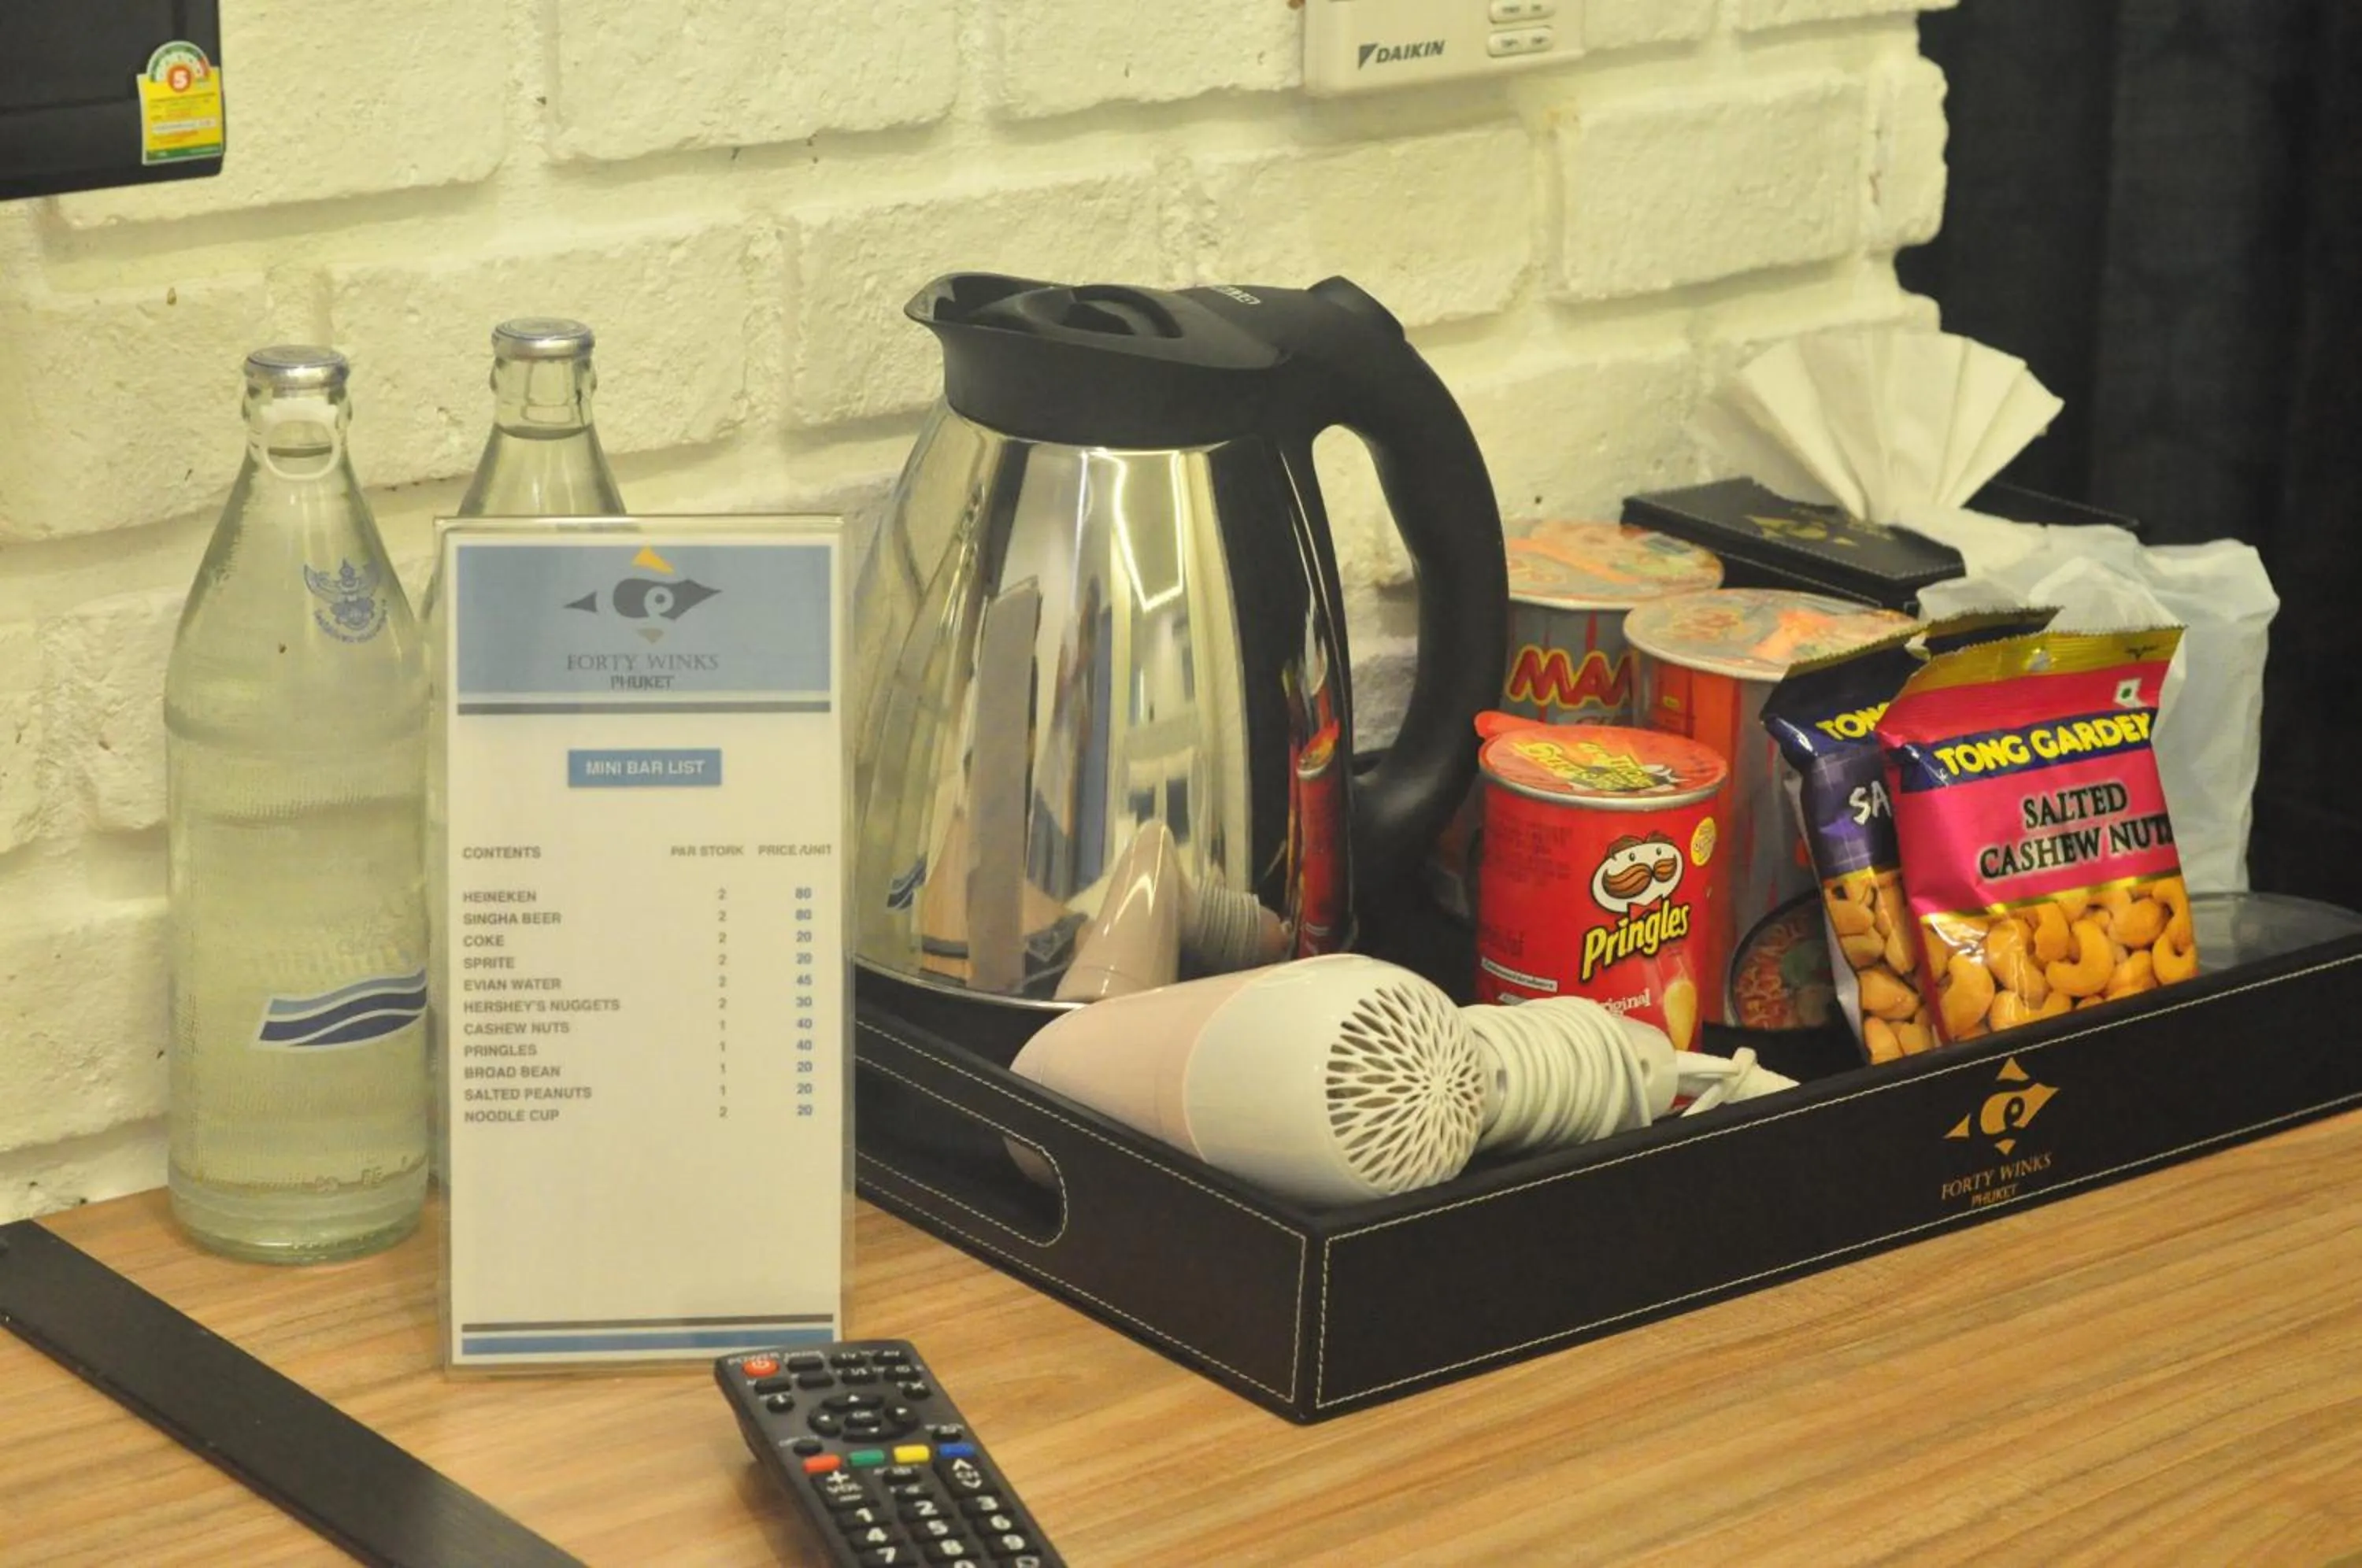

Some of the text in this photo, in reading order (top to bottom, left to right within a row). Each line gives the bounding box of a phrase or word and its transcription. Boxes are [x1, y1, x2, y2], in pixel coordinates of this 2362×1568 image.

[1375, 40, 1446, 64] DAIKIN
[566, 653, 719, 672] FORTY WINKS
[610, 675, 675, 690] PHUKET
[1815, 702, 1890, 741] TON
[1934, 736, 2031, 776] TONG
[585, 760, 705, 775] MINI BAR LIST
[2023, 782, 2127, 829] SALTED
[462, 845, 542, 860] CONTENTS
[1980, 828, 2101, 878] CASHEW
[717, 887, 727, 901] 2
[463, 912, 519, 926] SINGHA
[521, 912, 561, 925] BEER
[717, 909, 727, 923] 2
[463, 930, 813, 948] COKE 2 20
[1582, 900, 1690, 980] Pringles
[463, 952, 813, 970] SPRITE 2 20
[464, 978, 508, 992] EVIAN
[510, 978, 561, 990] WATER
[718, 974, 727, 989] 2
[463, 1000, 546, 1013] HERSHEY'S
[550, 998, 620, 1012] NUGGETS
[718, 997, 727, 1010] 2
[463, 1018, 813, 1036] CASHEW NUTS 1 40
[464, 1039, 813, 1057] PRINGLES 1 40
[464, 1060, 813, 1079] BROAD BEAN 1 20
[464, 1082, 813, 1102] SALTED PEANUTS 1 20
[464, 1104, 813, 1123] NOODLE CUP 2 20
[1942, 1152, 2052, 1200] FORTY WINKS
[1971, 1183, 2018, 1207] PHUKET
